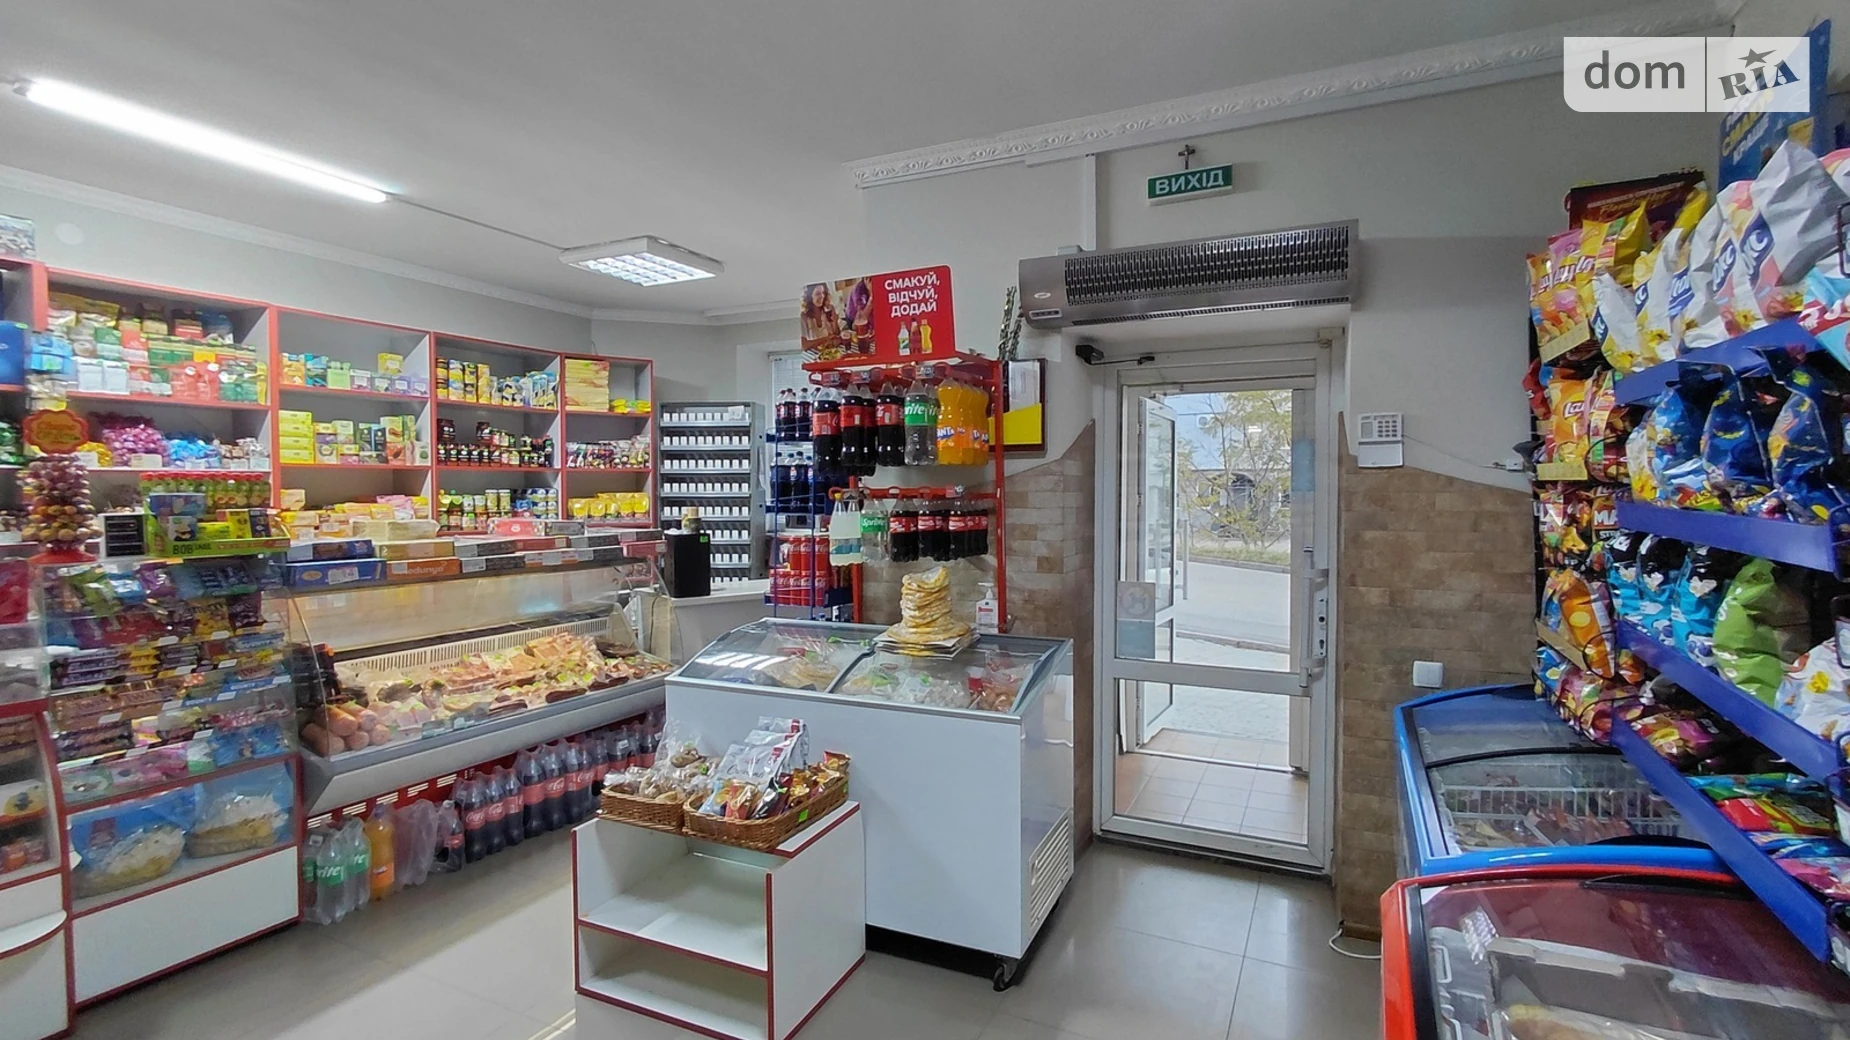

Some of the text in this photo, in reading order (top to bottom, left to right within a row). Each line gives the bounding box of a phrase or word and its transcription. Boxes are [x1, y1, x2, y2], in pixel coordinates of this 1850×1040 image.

[1155, 169, 1224, 195] ВИХІД
[884, 271, 940, 290] СМАКУЙ,
[888, 285, 938, 304] ВІДЧУЙ,
[891, 299, 937, 318] ДОДАЙ
